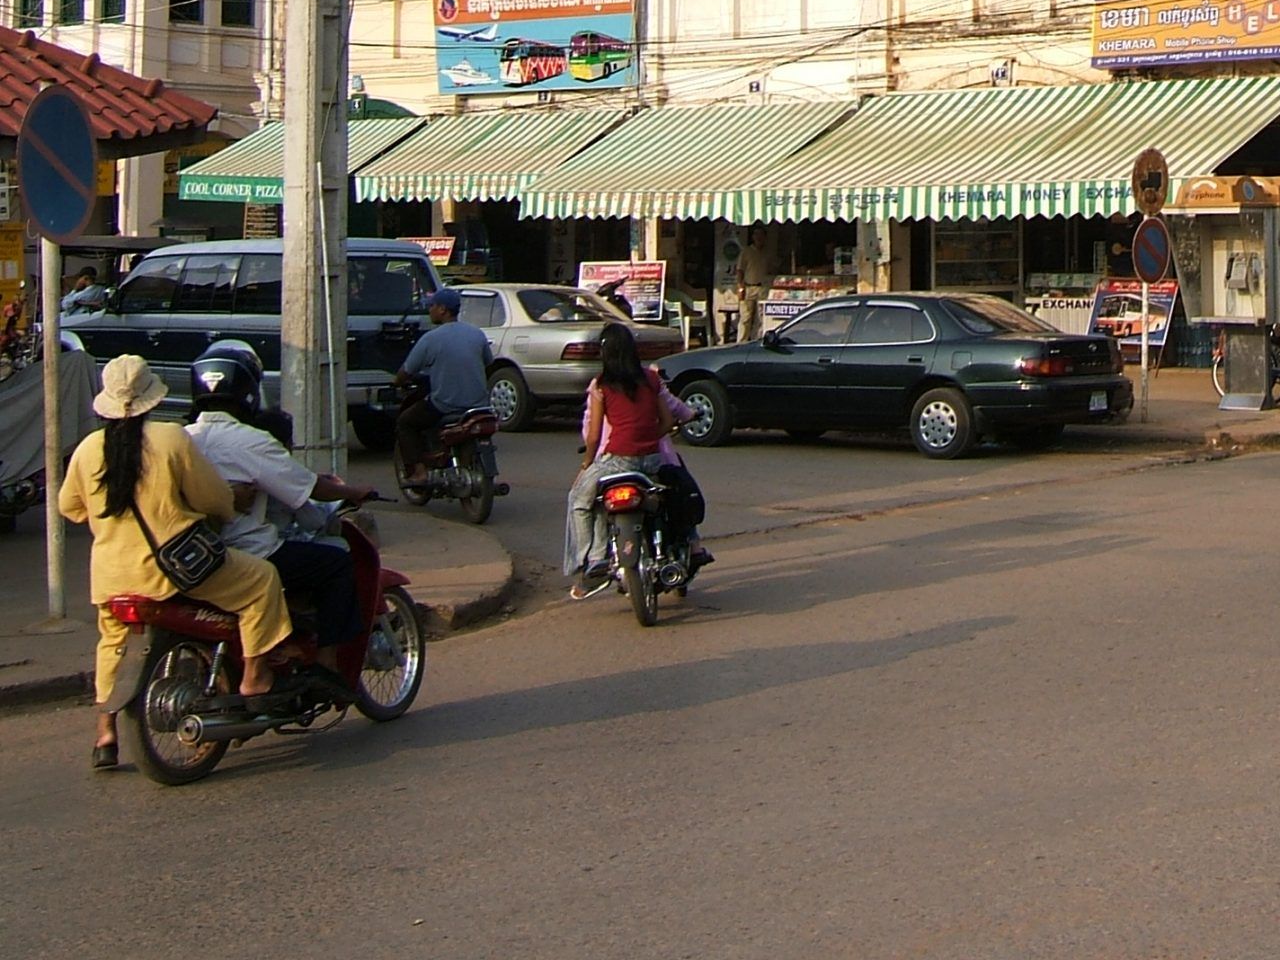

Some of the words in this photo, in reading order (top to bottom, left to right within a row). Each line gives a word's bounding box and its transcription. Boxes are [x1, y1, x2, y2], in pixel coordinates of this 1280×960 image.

[1100, 6, 1149, 29] ខេមរា
[1098, 38, 1156, 51] KHEMARA
[1165, 38, 1189, 48] Mobile
[1191, 36, 1216, 46] Phone
[1217, 35, 1237, 46] Shop
[185, 182, 210, 194] COOL
[212, 183, 252, 196] CORNER
[255, 185, 284, 198] PIZZA
[938, 190, 1006, 204] KHEMARA
[1020, 189, 1071, 202] MONEY
[1184, 192, 1226, 201] Payphone
[766, 305, 788, 314] MONEY
